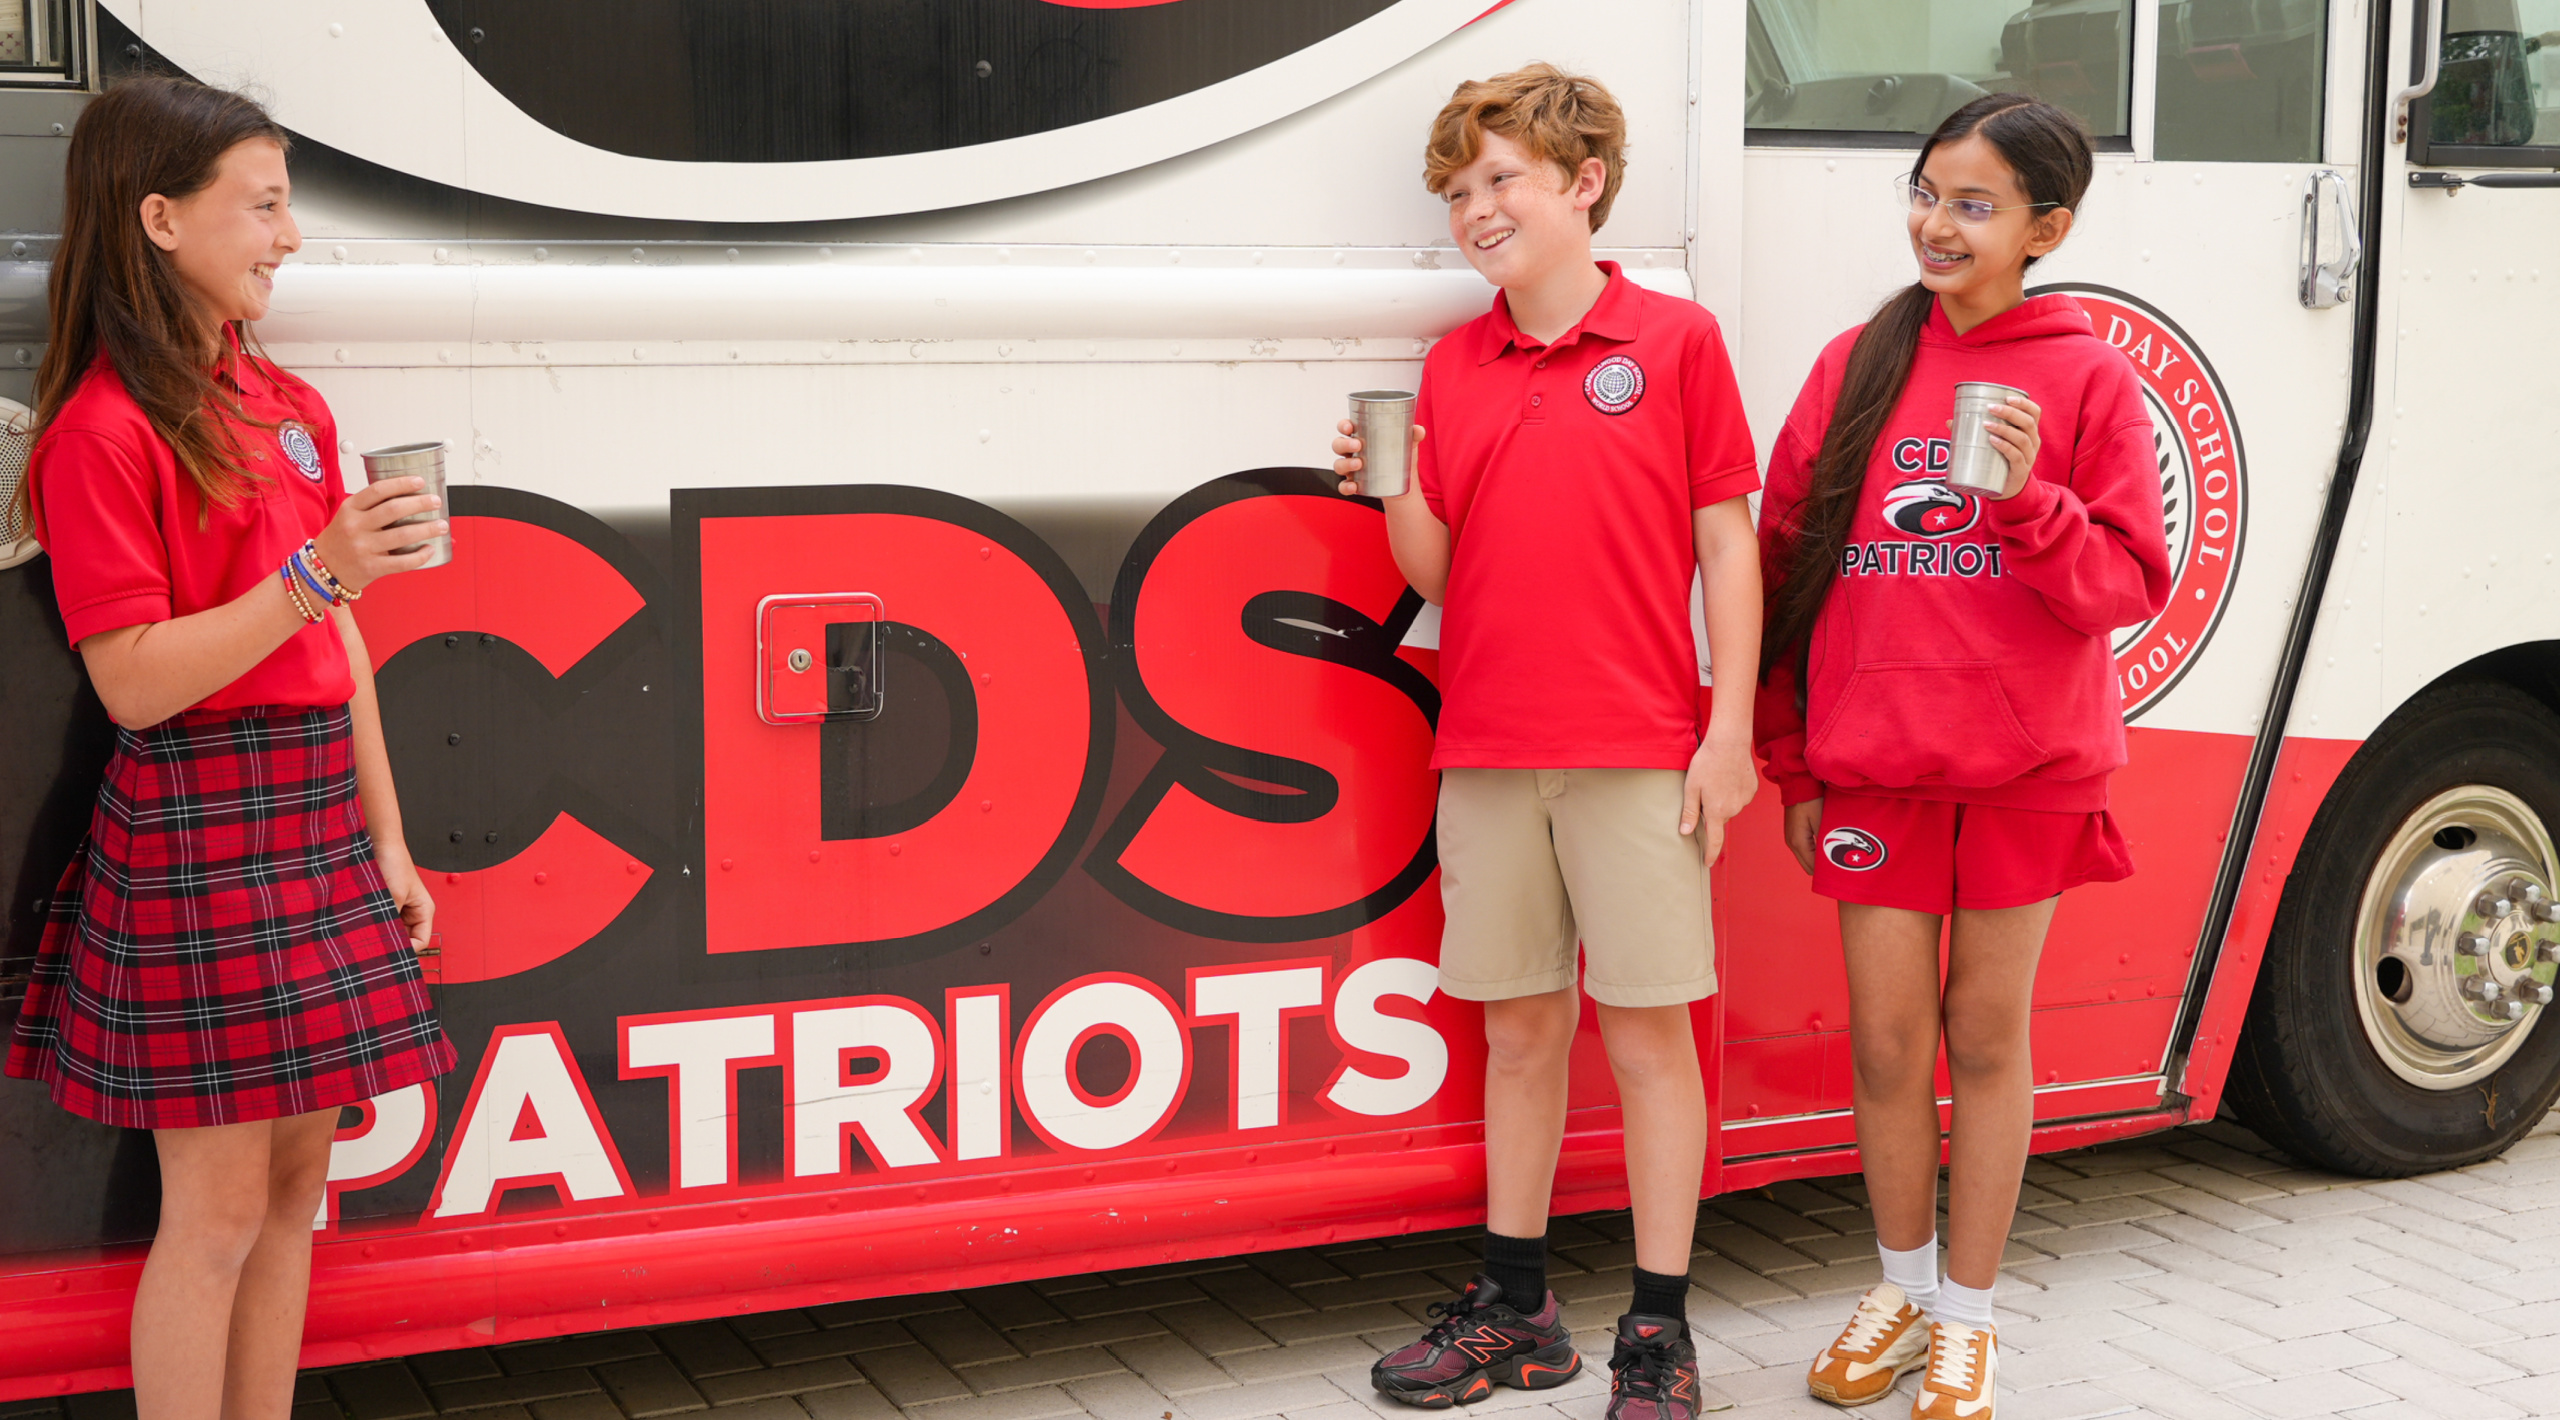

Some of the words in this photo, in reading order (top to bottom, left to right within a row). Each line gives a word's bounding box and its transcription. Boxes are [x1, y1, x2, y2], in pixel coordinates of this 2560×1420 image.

[1621, 357, 1635, 368] DAY
[1632, 366, 1644, 395] SCHOOL
[1591, 396, 1610, 412] WORLD
[1610, 401, 1634, 412] SCHOOL
[1892, 437, 1952, 472] CD
[2105, 314, 2181, 380] DAY
[2173, 378, 2230, 566] SCHOOL
[1840, 541, 2012, 578] PATRIOT
[352, 494, 1440, 984] CDS
